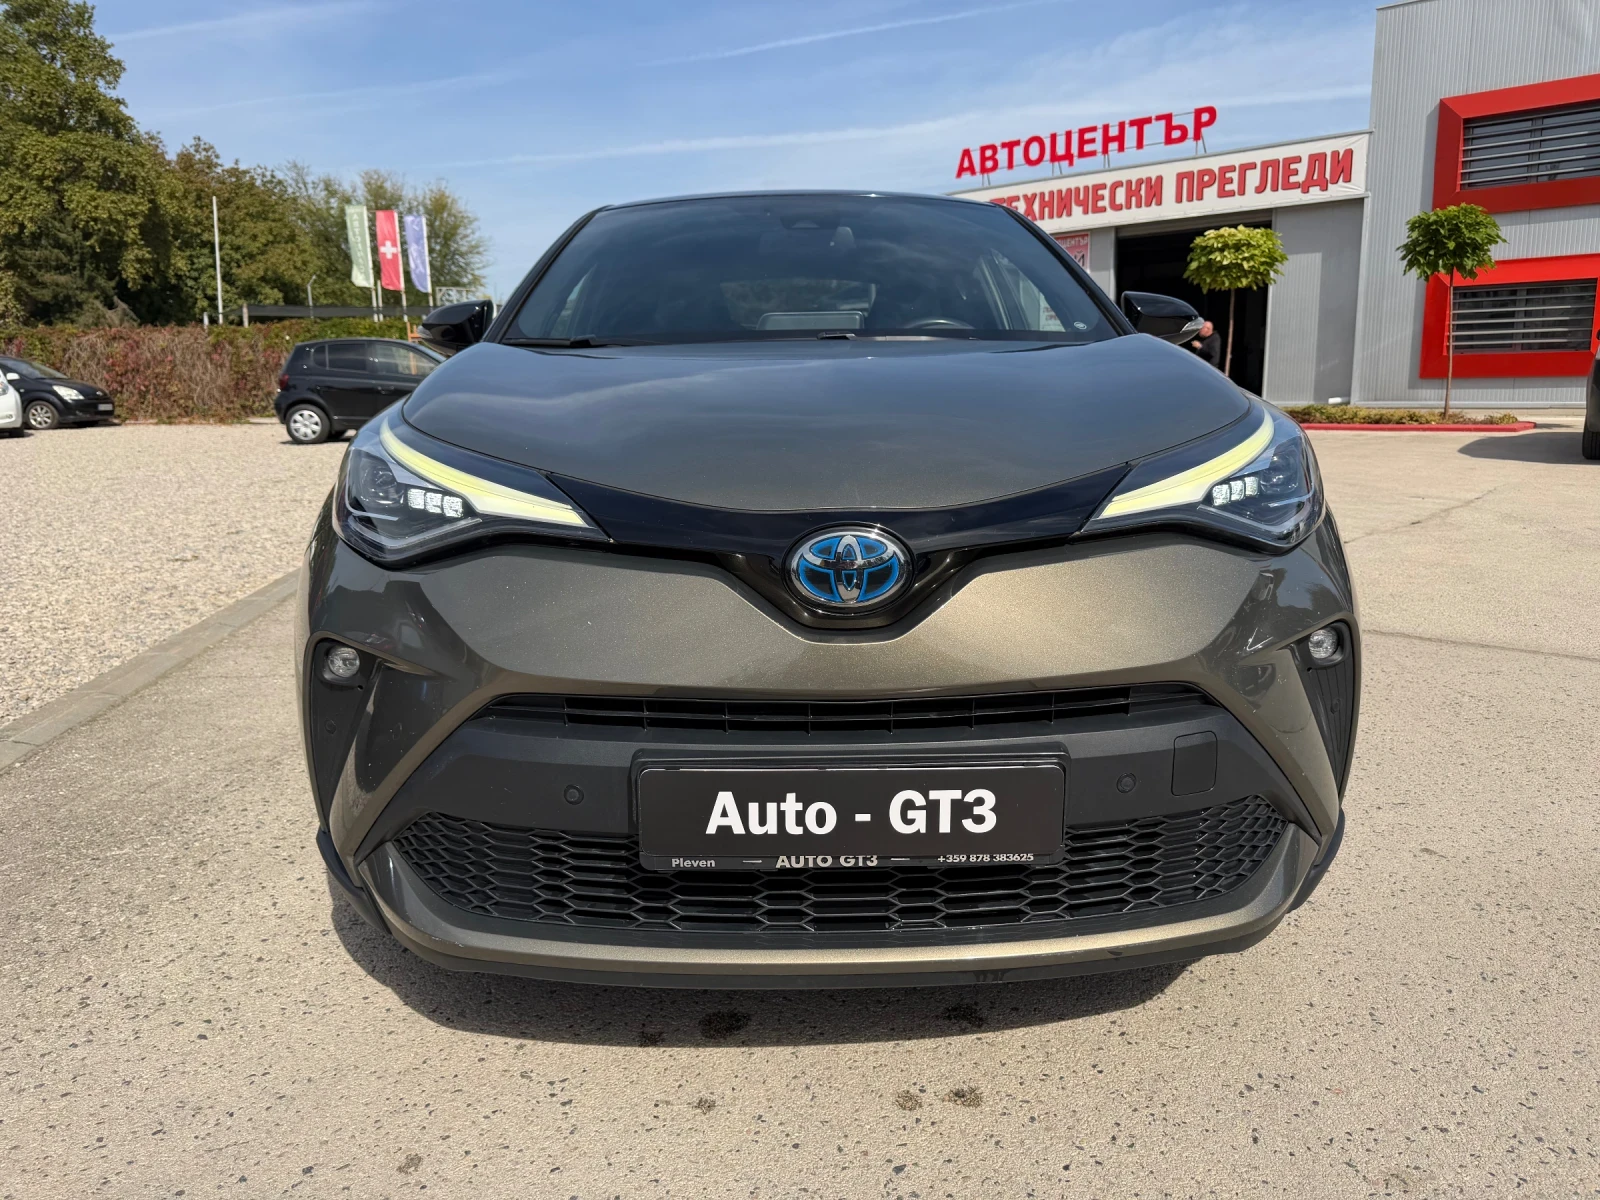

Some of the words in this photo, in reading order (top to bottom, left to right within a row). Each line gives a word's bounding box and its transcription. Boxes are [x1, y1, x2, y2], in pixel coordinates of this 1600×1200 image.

[955, 105, 1217, 179] АВТОЦЕНТЪР
[1175, 148, 1354, 204] ПРЕГЛЕДИ
[705, 791, 838, 835] Auto
[888, 788, 998, 834] GT3
[671, 858, 716, 868] Pleven
[775, 855, 833, 869] AUTO
[839, 855, 878, 867] GT3
[937, 854, 967, 863] +359
[969, 854, 991, 862] 878
[993, 853, 1034, 862] 383625
